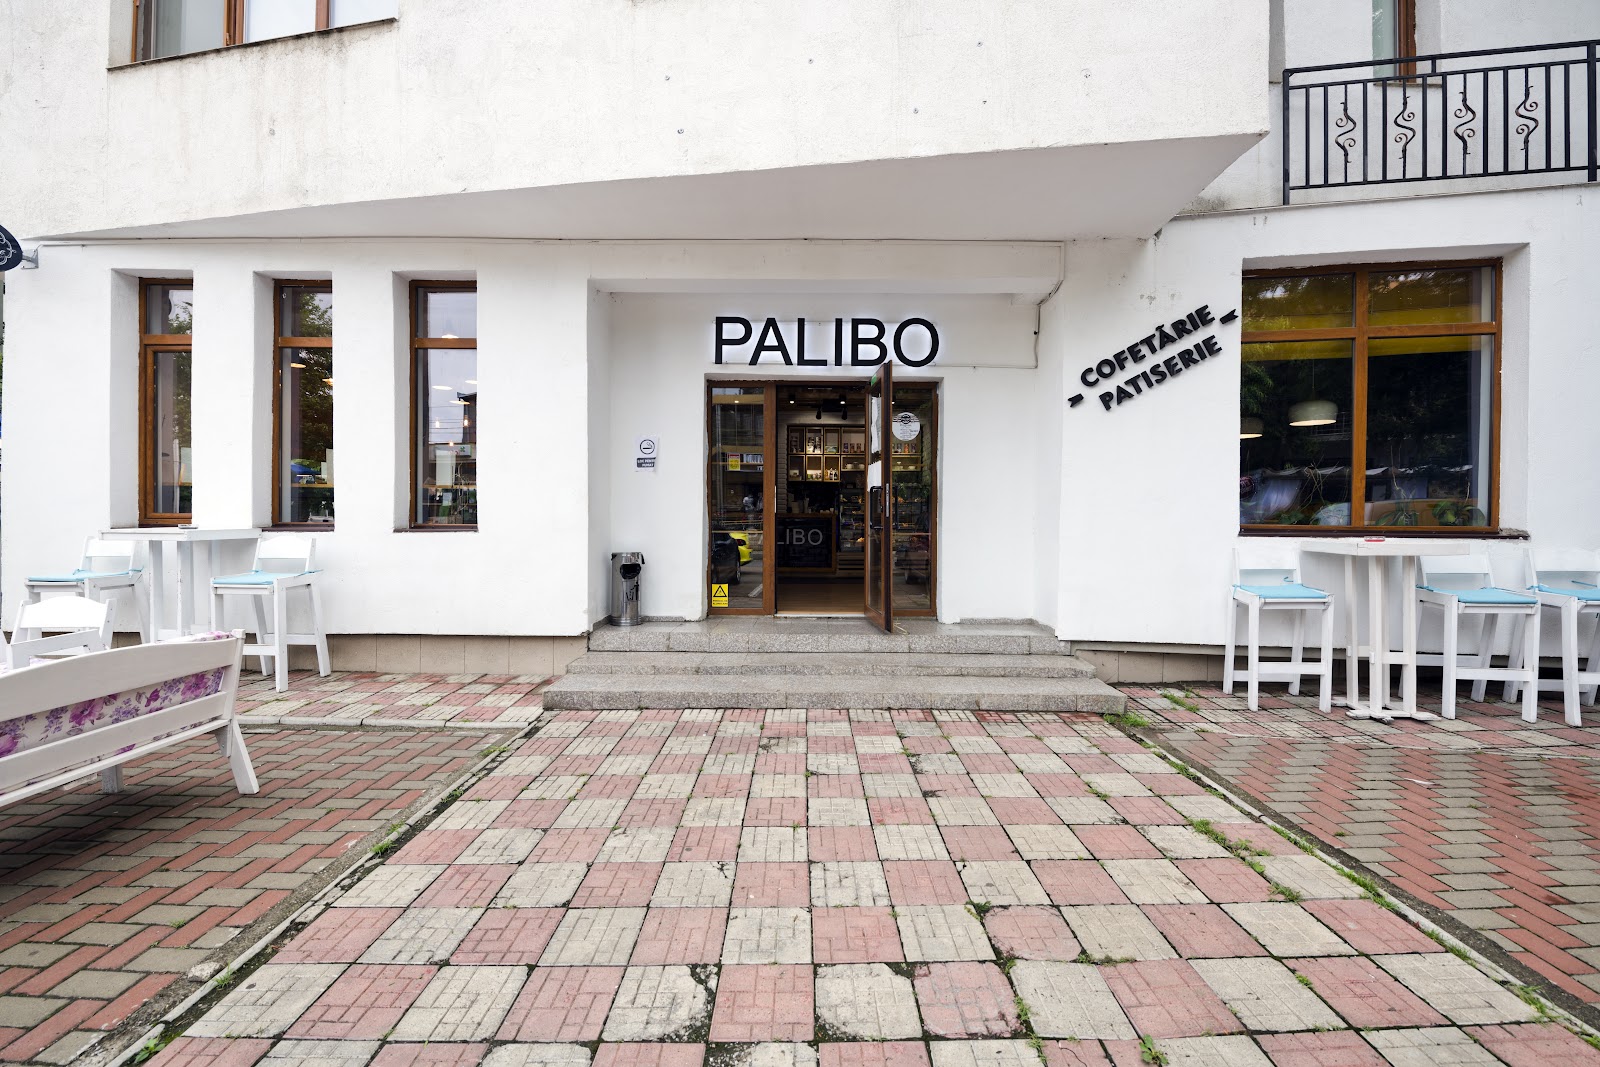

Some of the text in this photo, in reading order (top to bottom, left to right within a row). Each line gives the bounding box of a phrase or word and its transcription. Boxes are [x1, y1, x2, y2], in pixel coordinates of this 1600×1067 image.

[714, 316, 940, 367] PALIBO
[1080, 304, 1216, 388] COFETĂRIE
[1098, 334, 1223, 412] PATISERIE
